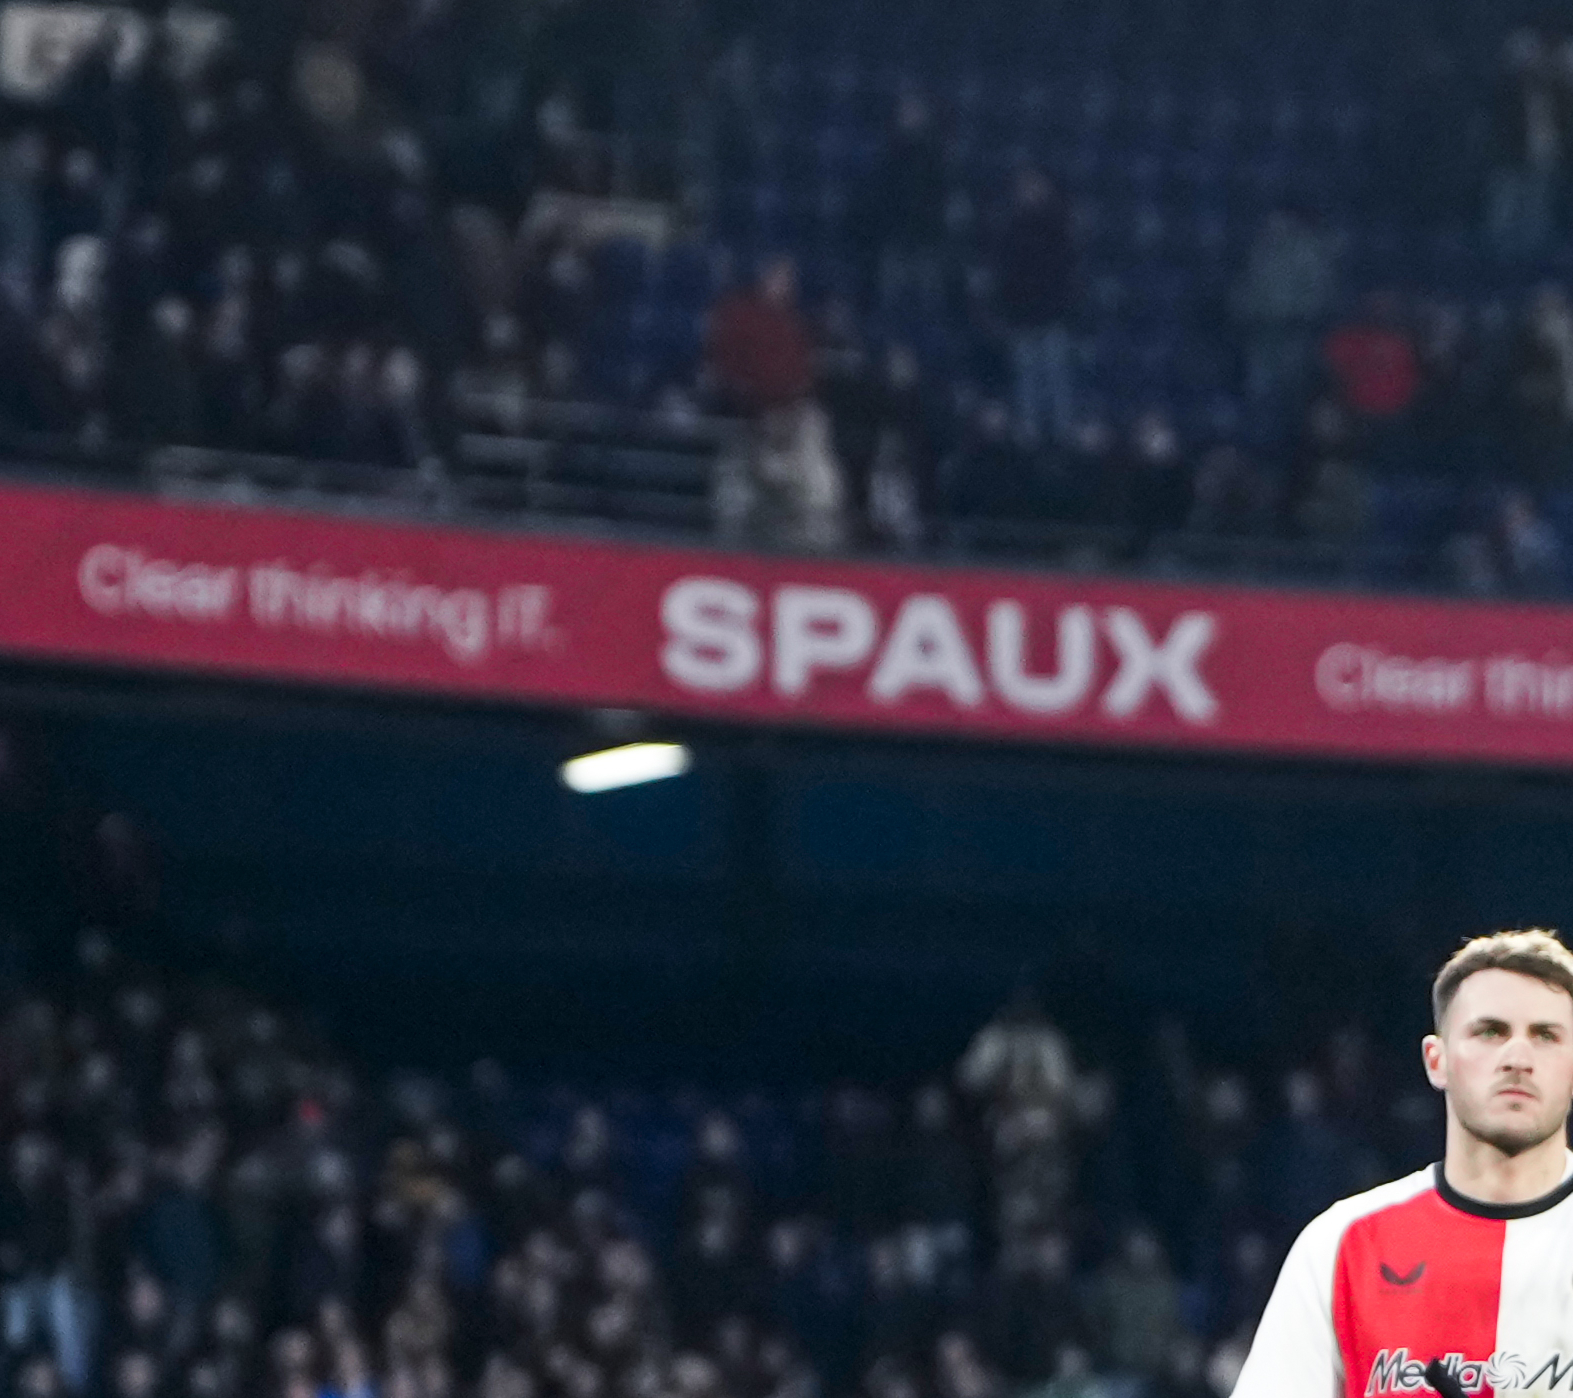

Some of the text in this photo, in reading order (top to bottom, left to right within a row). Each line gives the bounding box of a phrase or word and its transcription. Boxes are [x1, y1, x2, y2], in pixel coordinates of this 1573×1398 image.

[78, 544, 238, 622] Clear
[248, 558, 489, 665] thinking
[660, 576, 1218, 726] SPAUX
[1315, 641, 1476, 710] Clear
